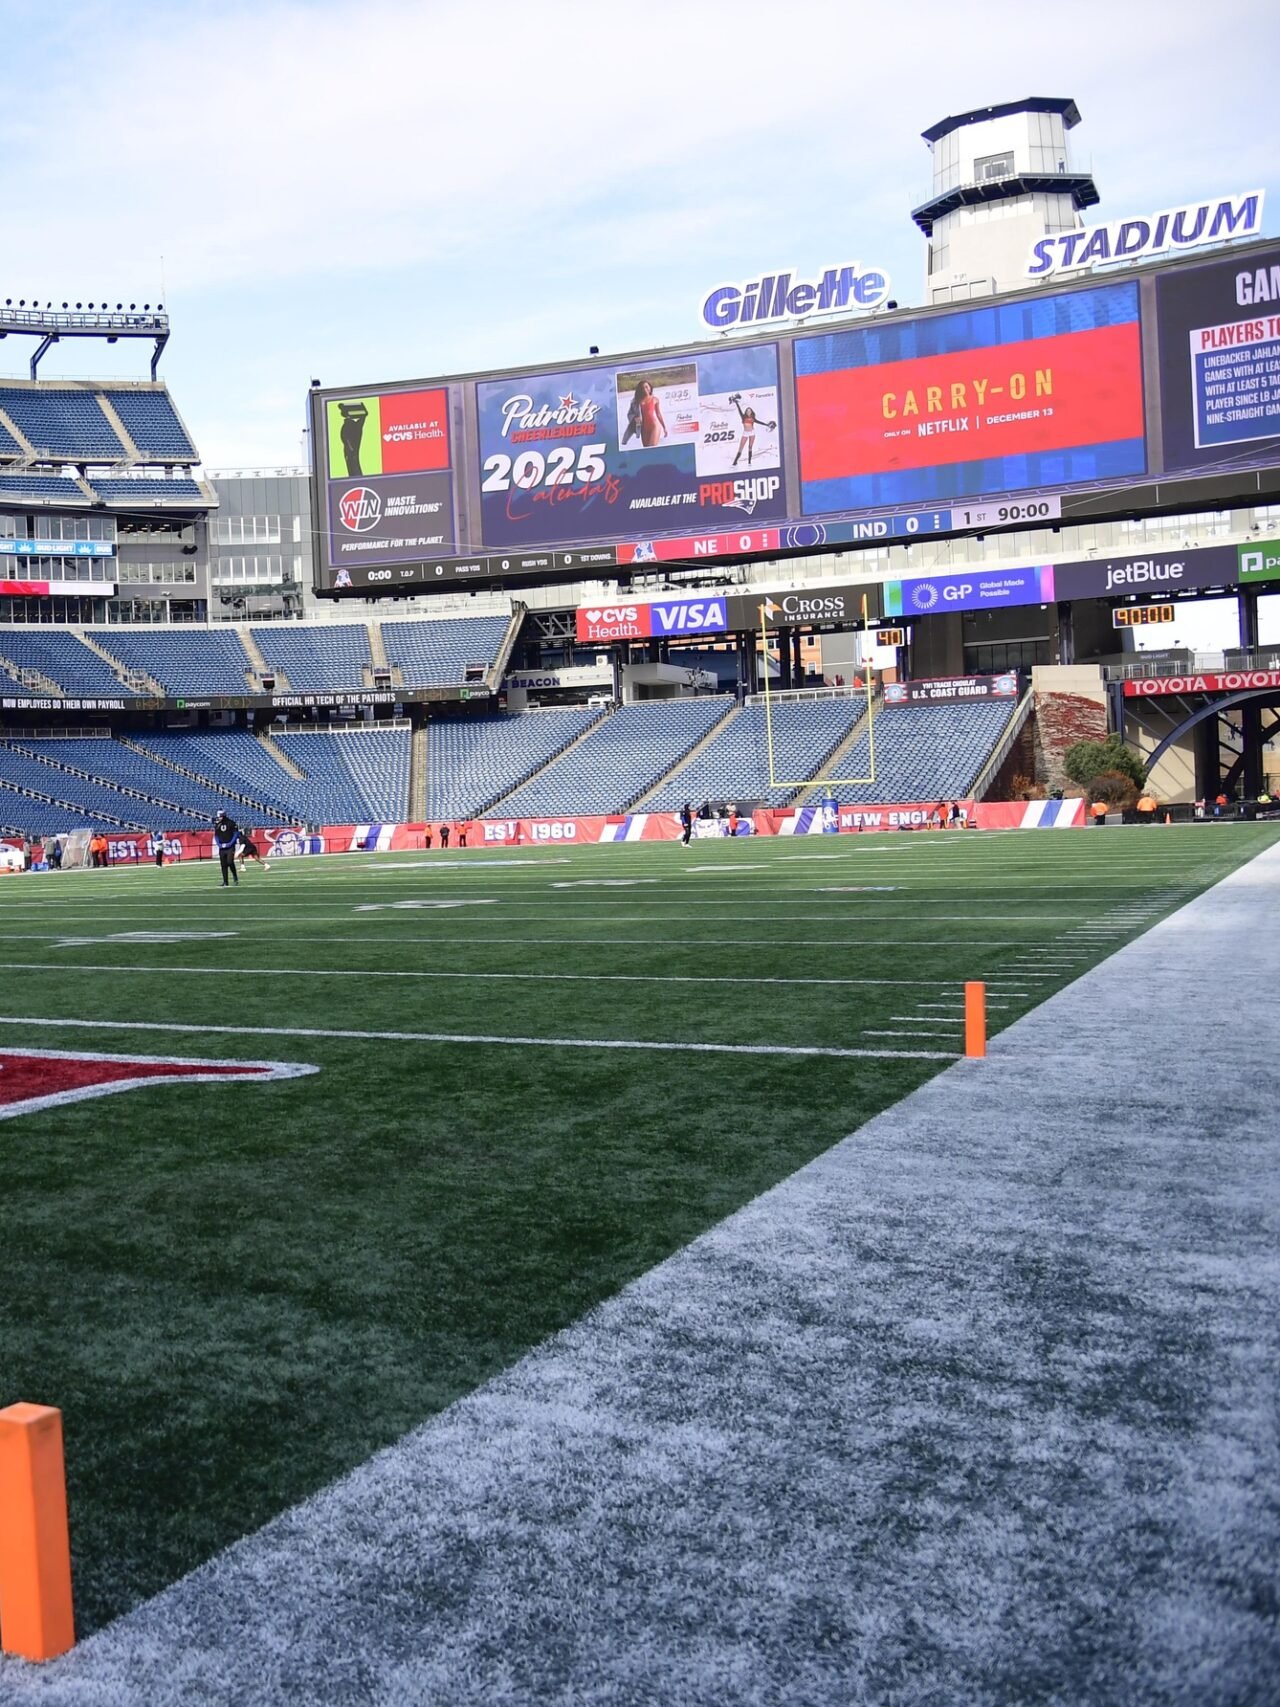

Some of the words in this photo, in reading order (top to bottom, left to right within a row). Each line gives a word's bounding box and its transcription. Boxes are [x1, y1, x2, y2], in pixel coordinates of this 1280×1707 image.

[1028, 195, 1259, 275] STADIUM
[702, 266, 887, 328] Gillette
[1201, 319, 1265, 350] PLAYERS
[1204, 351, 1251, 368] LINEBACKER
[1204, 367, 1232, 383] GAMES
[1233, 364, 1254, 379] WITH
[1254, 363, 1265, 376] AT
[882, 368, 1053, 419] CARRY-ON
[1205, 382, 1226, 396] WITH
[1226, 381, 1236, 394] AT
[1236, 378, 1260, 392] LEAST
[1261, 376, 1267, 388] 5
[1205, 397, 1235, 411] PLAYER
[1235, 394, 1259, 408] SINCE
[1259, 391, 1270, 403] LB
[501, 394, 601, 437] Patriots
[884, 430, 900, 438] ONLY
[918, 417, 969, 437] NETFLIX
[987, 410, 1040, 425] DECEMBER
[1042, 407, 1054, 416] 13
[1206, 404, 1265, 425] NINE-STRAIGHT
[389, 422, 426, 432] AVAILABLE
[429, 420, 438, 428] AT
[511, 423, 596, 443] CHEERLEADERS
[393, 431, 413, 442] CVS
[704, 430, 735, 444] 2025
[482, 443, 606, 493] 2025
[387, 495, 416, 506] WASTE
[506, 466, 624, 520] Calendars
[629, 496, 671, 512] AVAILABLE
[671, 494, 681, 506] AT
[681, 493, 697, 504] THE
[342, 498, 380, 520] WIN
[963, 511, 971, 525] 1
[976, 512, 987, 522] ST
[998, 503, 1050, 521] 90:00
[852, 521, 887, 538] IND
[905, 517, 919, 533] 0
[341, 539, 389, 552] PERFORMANCE
[390, 538, 404, 548] FOR
[405, 537, 419, 547] THE
[419, 535, 444, 546] PLANET
[694, 539, 718, 554] NE
[740, 535, 751, 549] 0
[501, 560, 510, 570] 0
[564, 555, 572, 564] 0
[368, 569, 392, 580] 0:00
[435, 565, 443, 575] 0
[1105, 560, 1184, 590] jetBlue
[979, 581, 1003, 589] Global
[1003, 579, 1025, 587] Made
[980, 589, 1011, 598] Possible
[781, 595, 845, 614] CROSS
[602, 607, 638, 622] CVS
[652, 601, 725, 630] VISA
[784, 610, 846, 622] INSURANCE
[1116, 604, 1173, 625] 90:00
[878, 628, 900, 645] 40
[511, 677, 561, 689] BEACON
[911, 690, 929, 699] U.S.
[930, 687, 957, 698] COAST
[957, 685, 988, 696] GUARD
[1132, 677, 1207, 695] TOYOTA
[1214, 671, 1280, 689] TOYOT
[2, 698, 17, 708] NOW
[17, 699, 52, 709] EMPLOYEES
[52, 699, 61, 709] DO
[62, 699, 80, 709] THEIR
[81, 700, 96, 710] OWN
[97, 700, 126, 710] PAYROLL
[185, 702, 211, 710] paycom
[272, 696, 303, 706] OFFICIAL
[304, 695, 315, 705] HR
[316, 695, 335, 705] TECH
[336, 694, 345, 704] OF
[347, 693, 360, 703] THE
[361, 692, 396, 703] PATRIOTS
[840, 813, 882, 827] NEW
[483, 821, 525, 841] EST.
[531, 822, 576, 840] 1960
[108, 839, 143, 858] EST.
